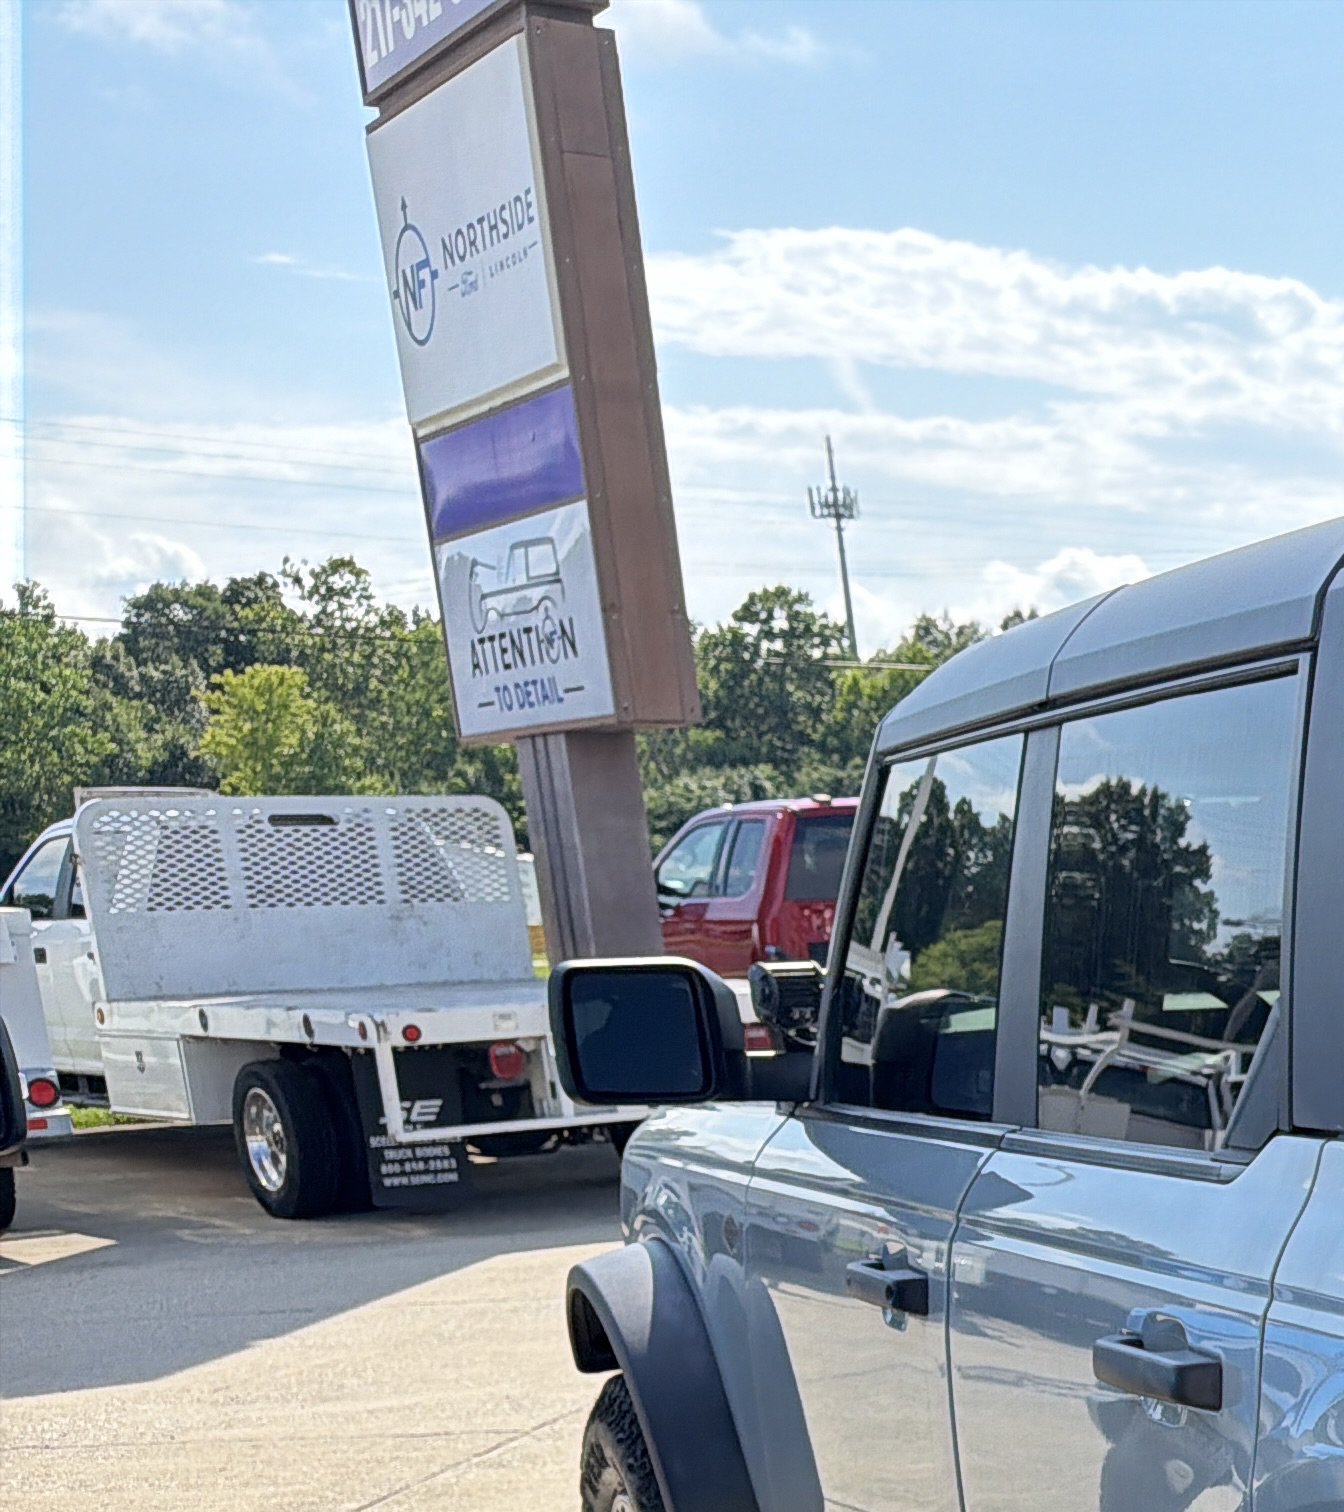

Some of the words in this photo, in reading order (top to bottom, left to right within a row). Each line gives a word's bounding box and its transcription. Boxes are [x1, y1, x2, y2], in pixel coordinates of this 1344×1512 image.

[441, 187, 534, 271] NORTHSIDE
[402, 258, 431, 311] NF
[470, 616, 579, 678] ATTENTION
[494, 684, 514, 712] TO
[515, 676, 564, 709] DETAIL
